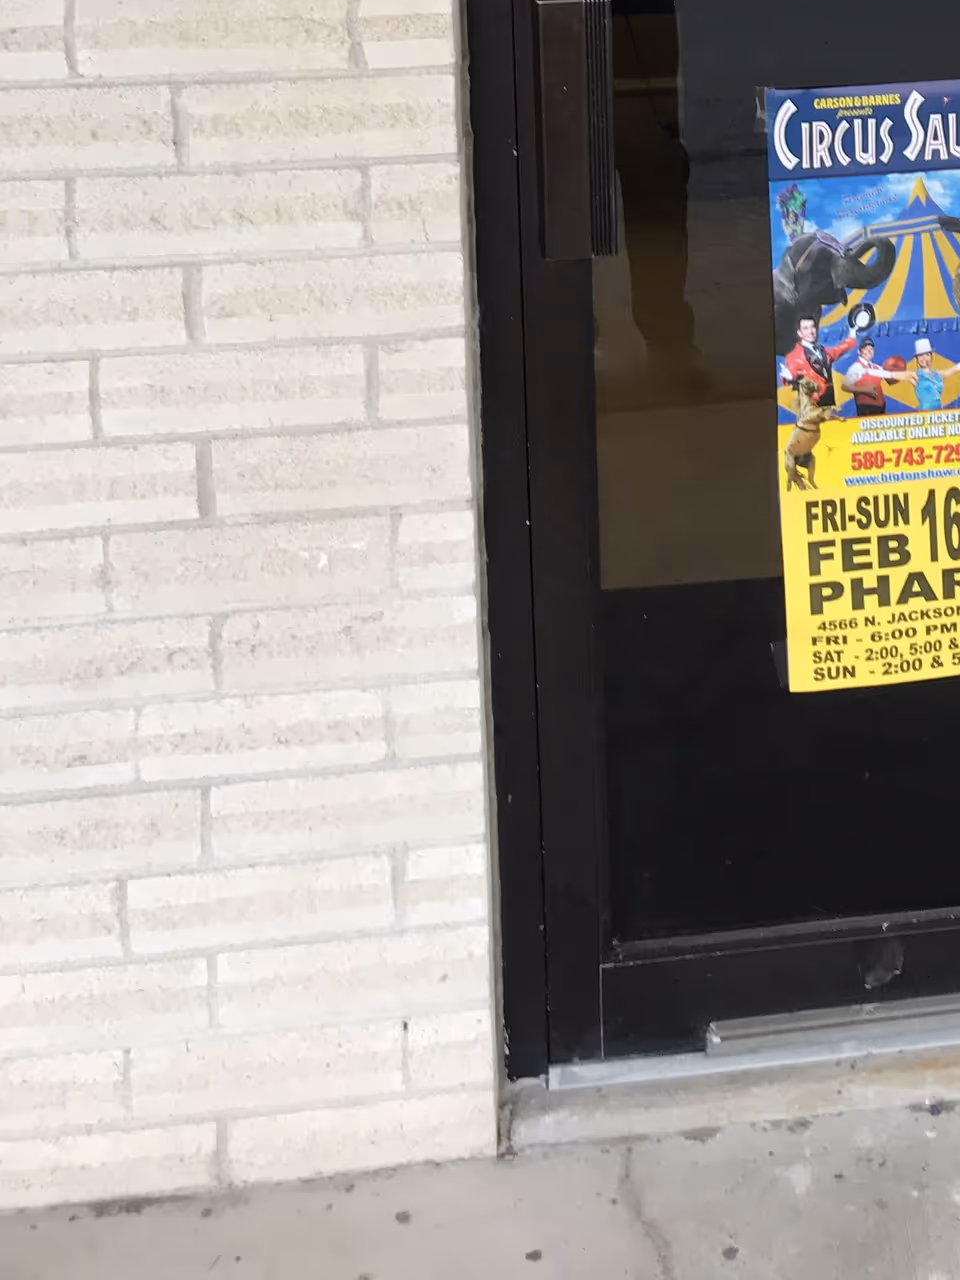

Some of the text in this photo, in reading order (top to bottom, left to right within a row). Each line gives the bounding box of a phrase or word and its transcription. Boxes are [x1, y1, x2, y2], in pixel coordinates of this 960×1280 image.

[773, 98, 895, 171] CIRCUS
[851, 429, 907, 445] AVAILABLE
[908, 425, 946, 440] ONLINE
[860, 415, 925, 431] DISCOUNTED
[805, 492, 911, 535] FRI-SUN
[807, 533, 911, 577] FEB
[811, 635, 848, 647] FRI
[870, 627, 917, 643] 6:00
[925, 622, 958, 636] PM
[818, 620, 859, 633] 4566
[864, 616, 881, 627] N.
[812, 650, 844, 664] SAT
[865, 646, 905, 662] 2:00,
[909, 639, 943, 656] 5:00
[948, 638, 960, 650] &
[813, 665, 857, 682] SUN
[882, 658, 923, 676] 2:00
[930, 655, 944, 669] &
